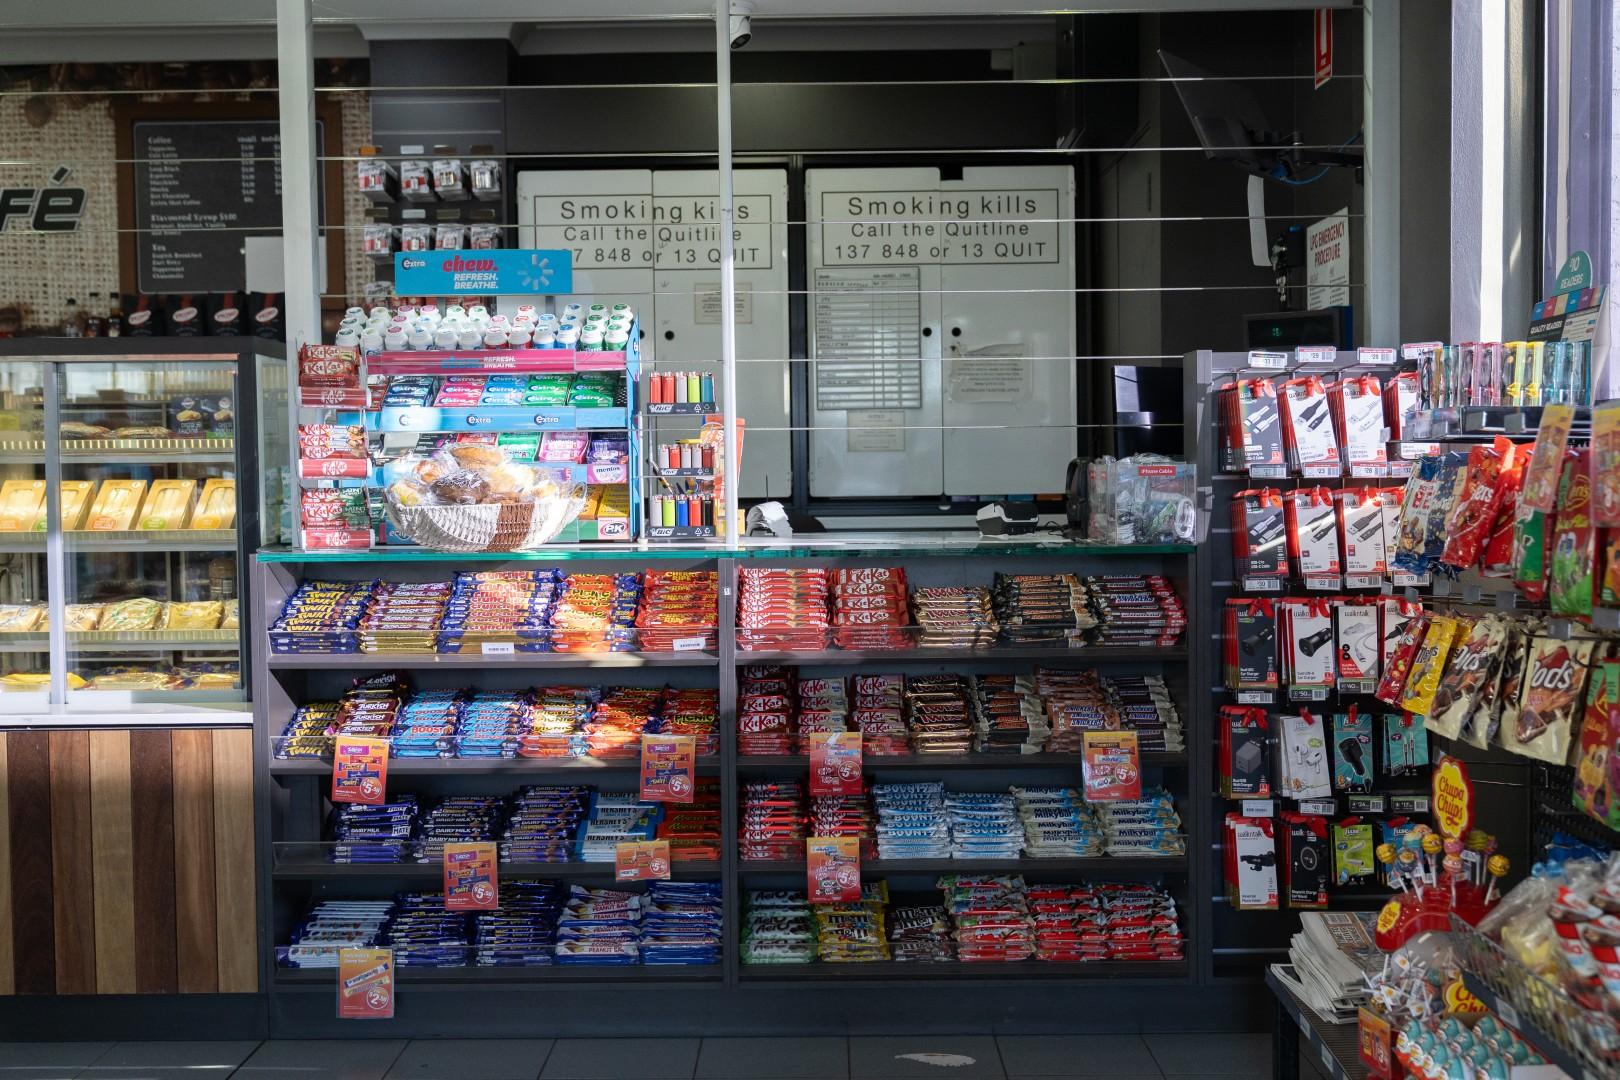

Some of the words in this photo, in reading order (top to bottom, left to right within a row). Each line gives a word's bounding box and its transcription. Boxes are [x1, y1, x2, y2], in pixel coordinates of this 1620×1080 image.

[561, 201, 682, 223] Smoking
[694, 201, 749, 219] kis
[848, 197, 969, 219] Smoking
[981, 196, 1037, 214] kills
[564, 226, 604, 241] Call
[616, 227, 647, 240] the
[659, 227, 742, 242] Quitlie
[851, 223, 892, 238] Call
[903, 223, 935, 237] the
[945, 222, 1030, 238] Quitline
[1319, 221, 1345, 245] EMERGENCY
[595, 249, 631, 263] 848
[642, 252, 662, 264] or
[675, 249, 697, 264] 13
[835, 245, 870, 259] 137
[882, 244, 919, 258] 848
[930, 247, 949, 257] or
[961, 244, 983, 257] 13
[994, 242, 1047, 257] QUIT
[1315, 243, 1341, 269] PROCEDURE
[454, 273, 499, 282] REFRESH.
[454, 281, 499, 290] BREATHE.
[1438, 775, 1465, 803] Chupa
[1437, 794, 1464, 821] Chups
